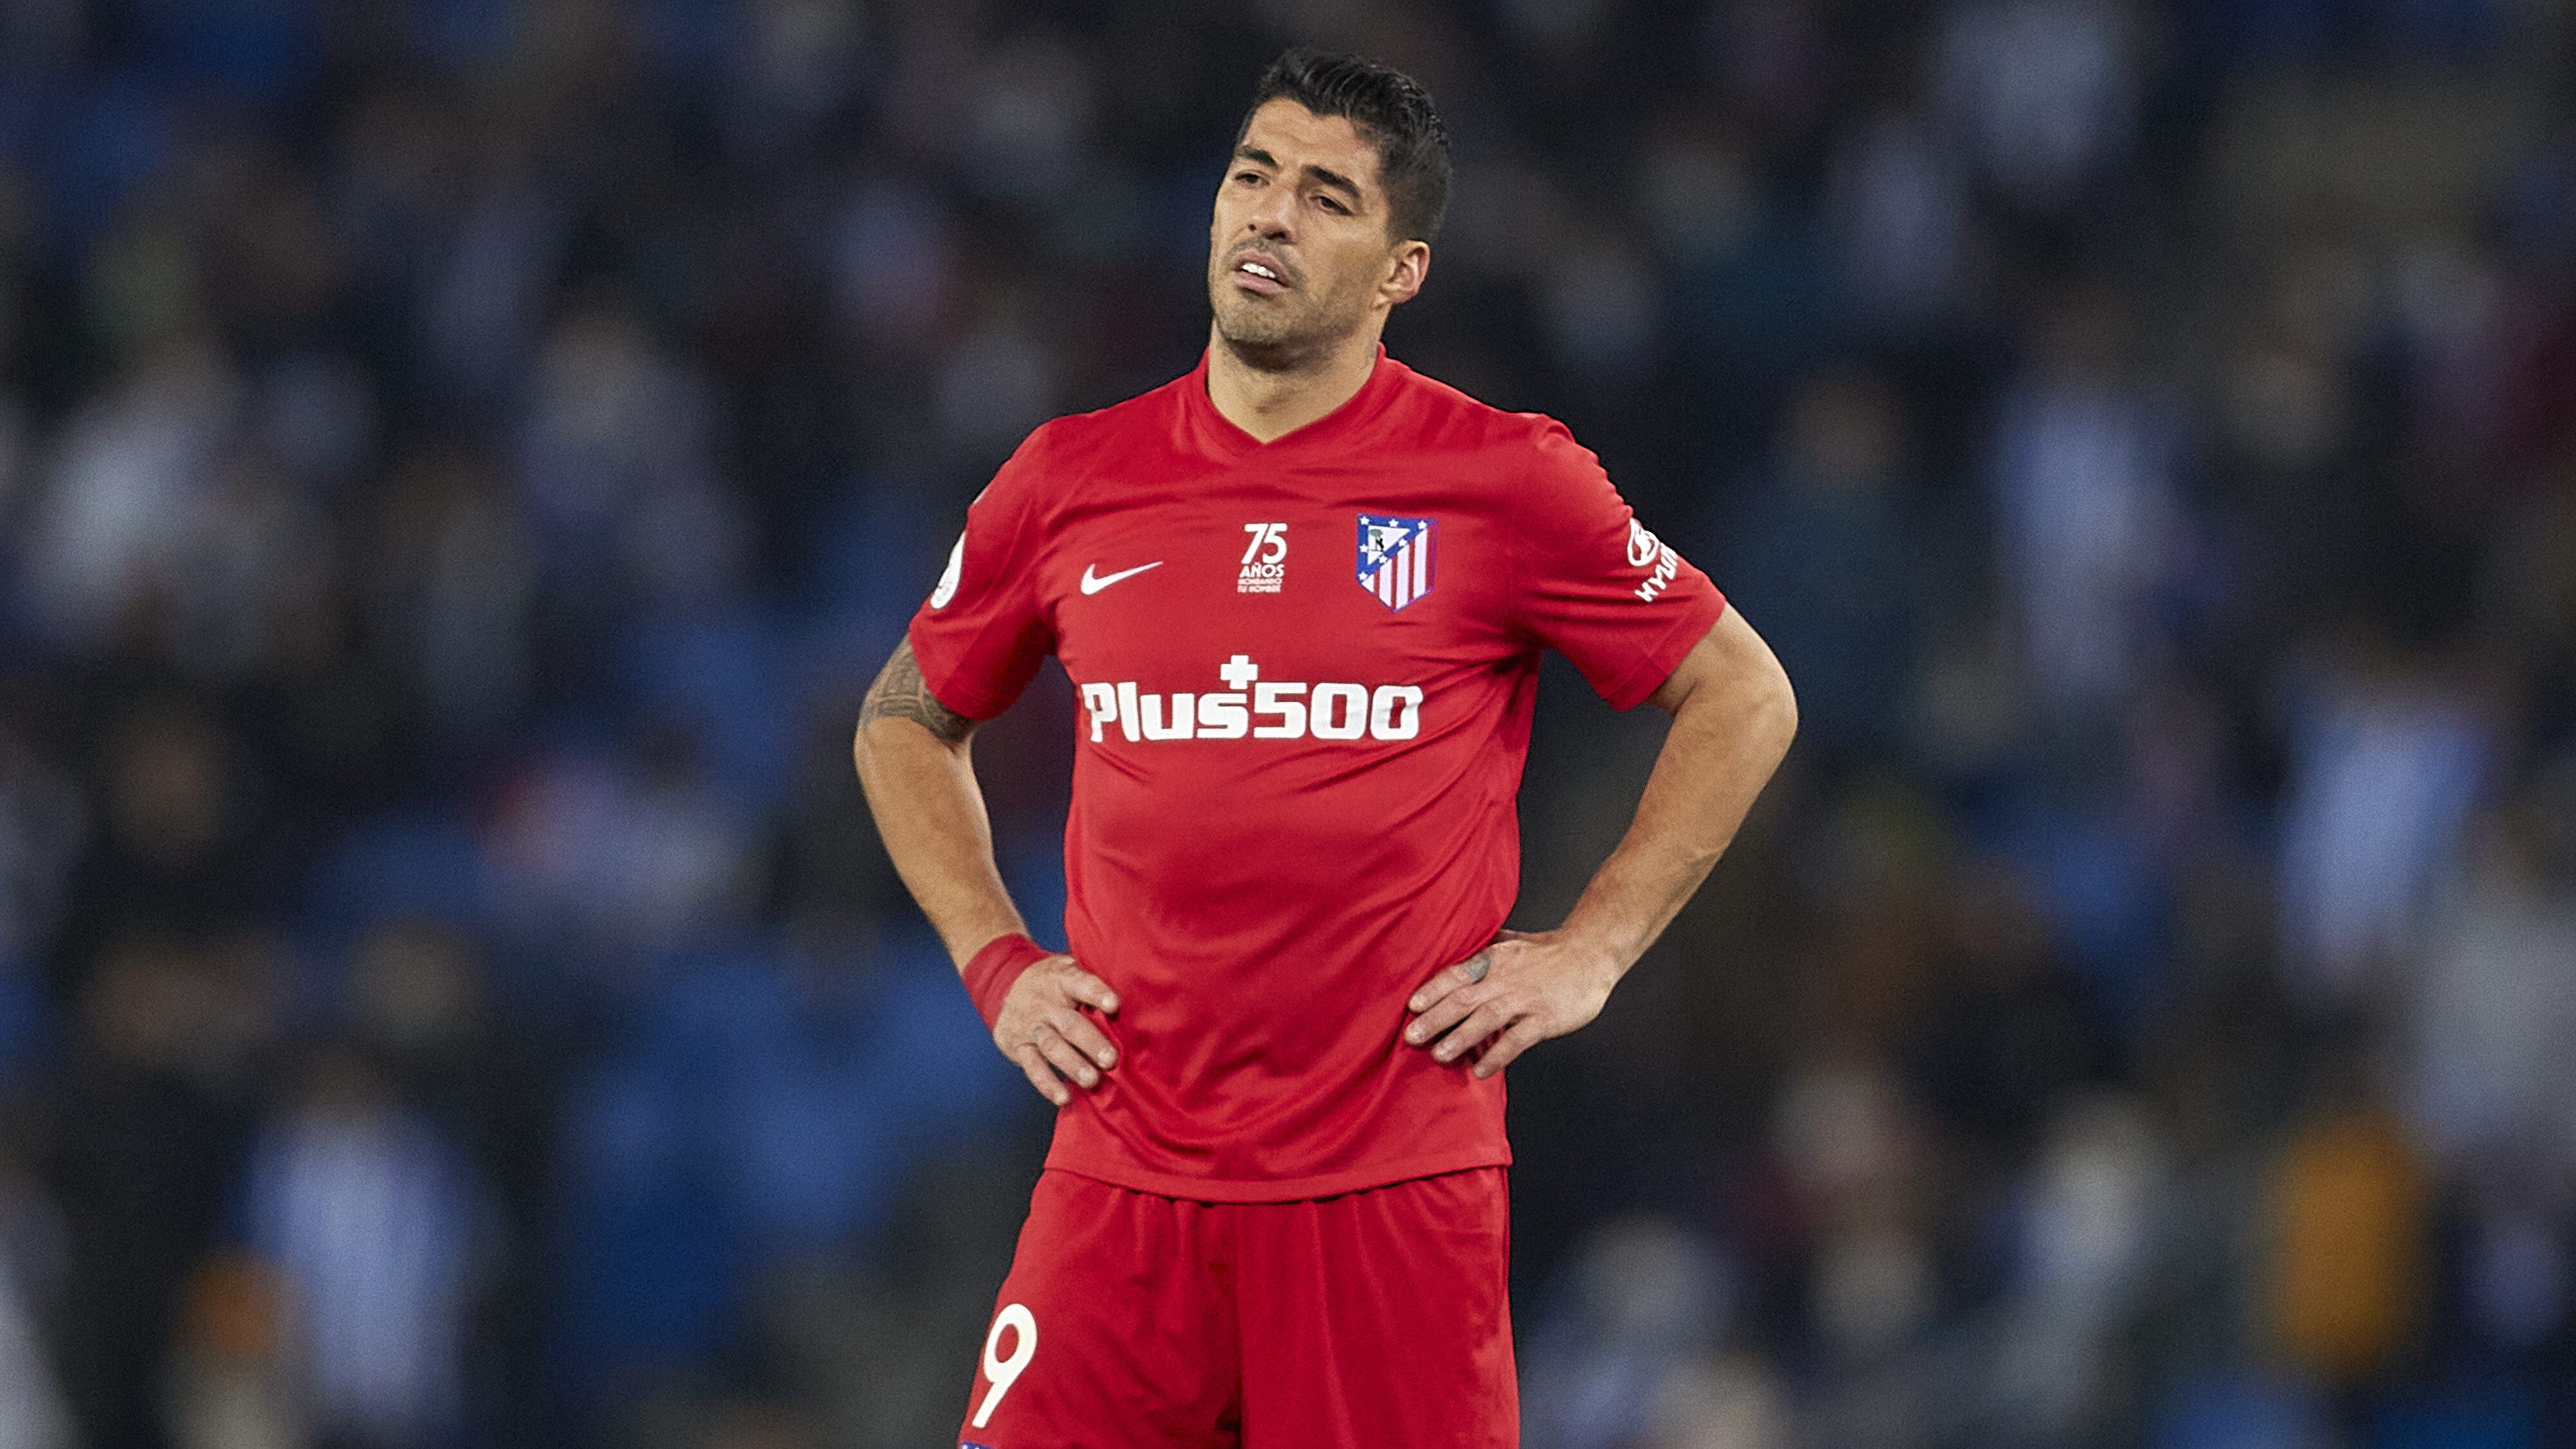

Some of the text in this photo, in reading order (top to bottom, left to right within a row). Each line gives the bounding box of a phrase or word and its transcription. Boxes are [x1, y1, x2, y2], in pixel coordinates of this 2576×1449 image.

[1241, 523, 1287, 564] 75
[1239, 562, 1285, 578] AÑOS
[1081, 681, 1424, 743] Plus500
[972, 1303, 1037, 1428] 9
